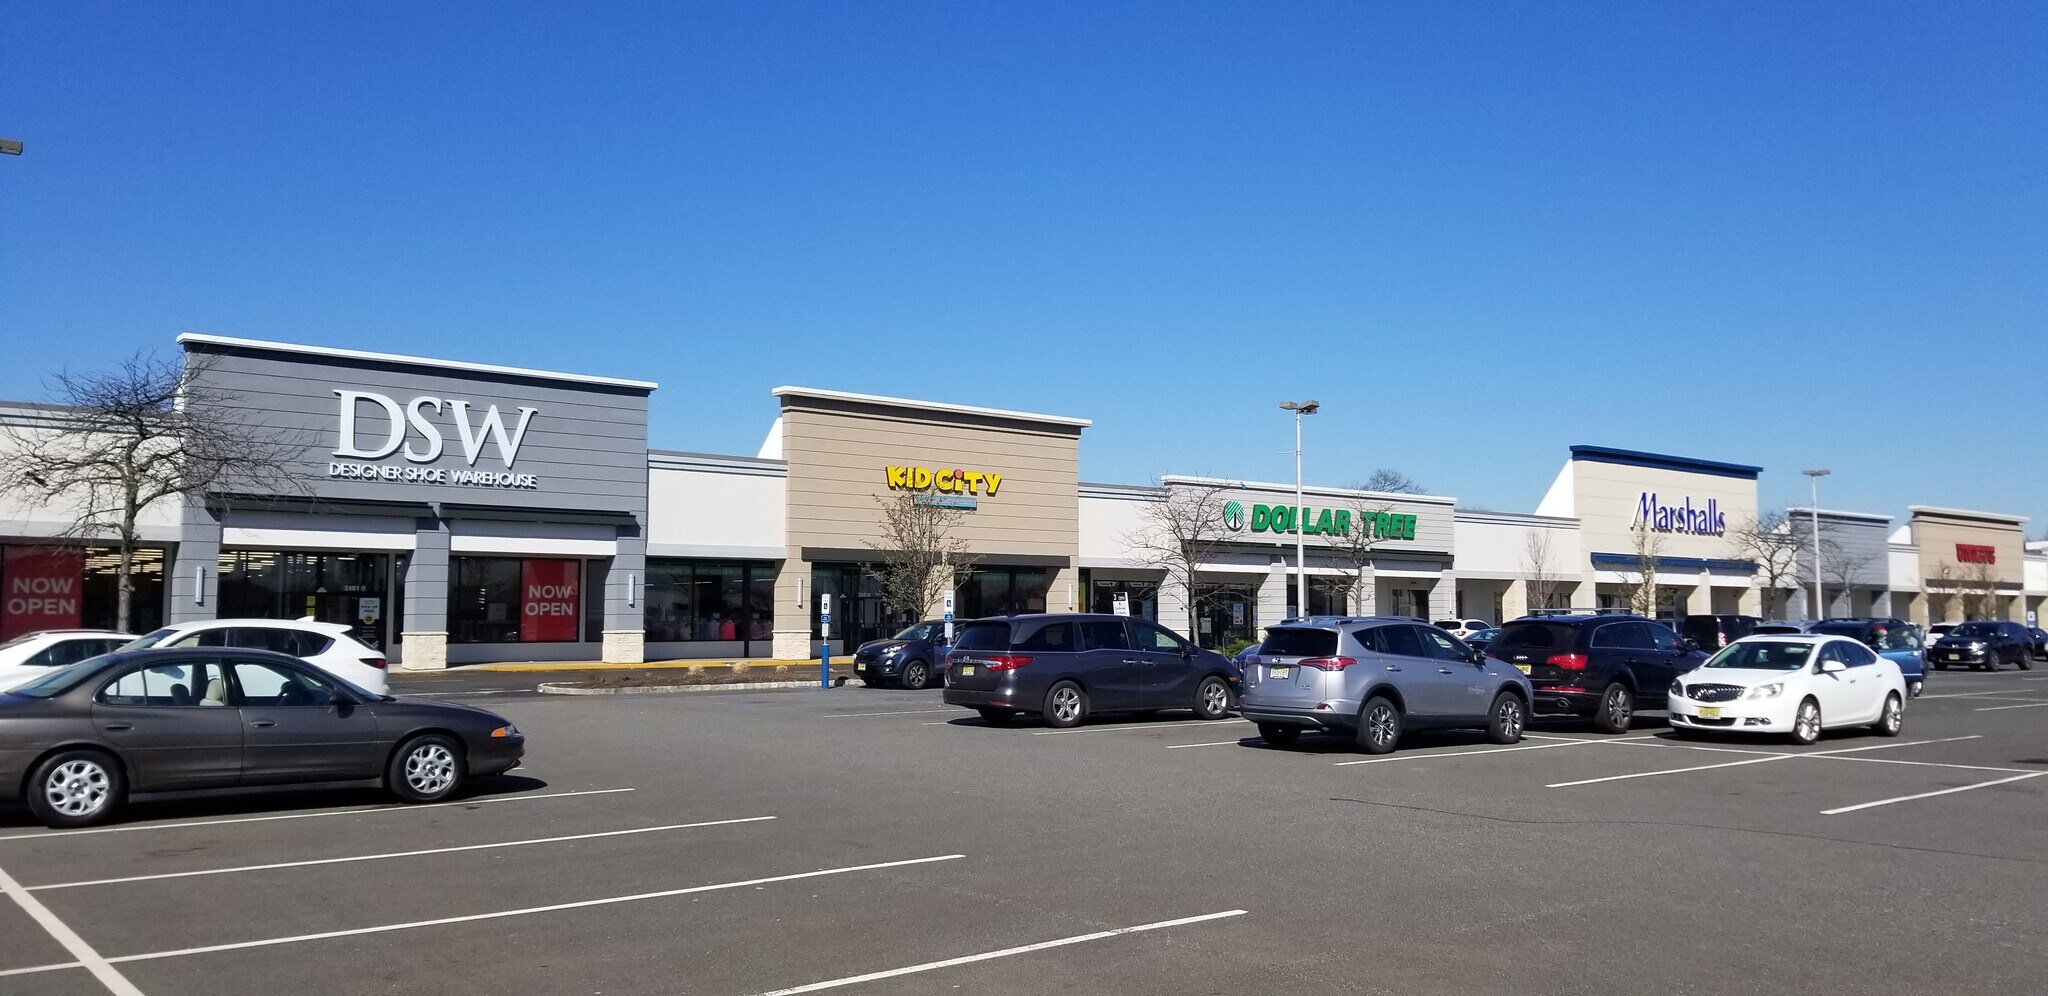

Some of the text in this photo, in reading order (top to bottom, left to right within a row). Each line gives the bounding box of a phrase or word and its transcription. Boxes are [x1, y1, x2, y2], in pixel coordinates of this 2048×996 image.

[332, 389, 539, 469] DSW
[329, 462, 538, 490] DESIGNER SHOE WAREHOUSE
[885, 465, 932, 491] KID
[1251, 504, 1417, 540] DOLLAR TREE
[1630, 492, 1725, 537] Marshalls
[12, 577, 74, 594] NOW
[528, 585, 572, 599] NOW
[7, 598, 76, 615] OPEN
[525, 602, 574, 616] OPEN
